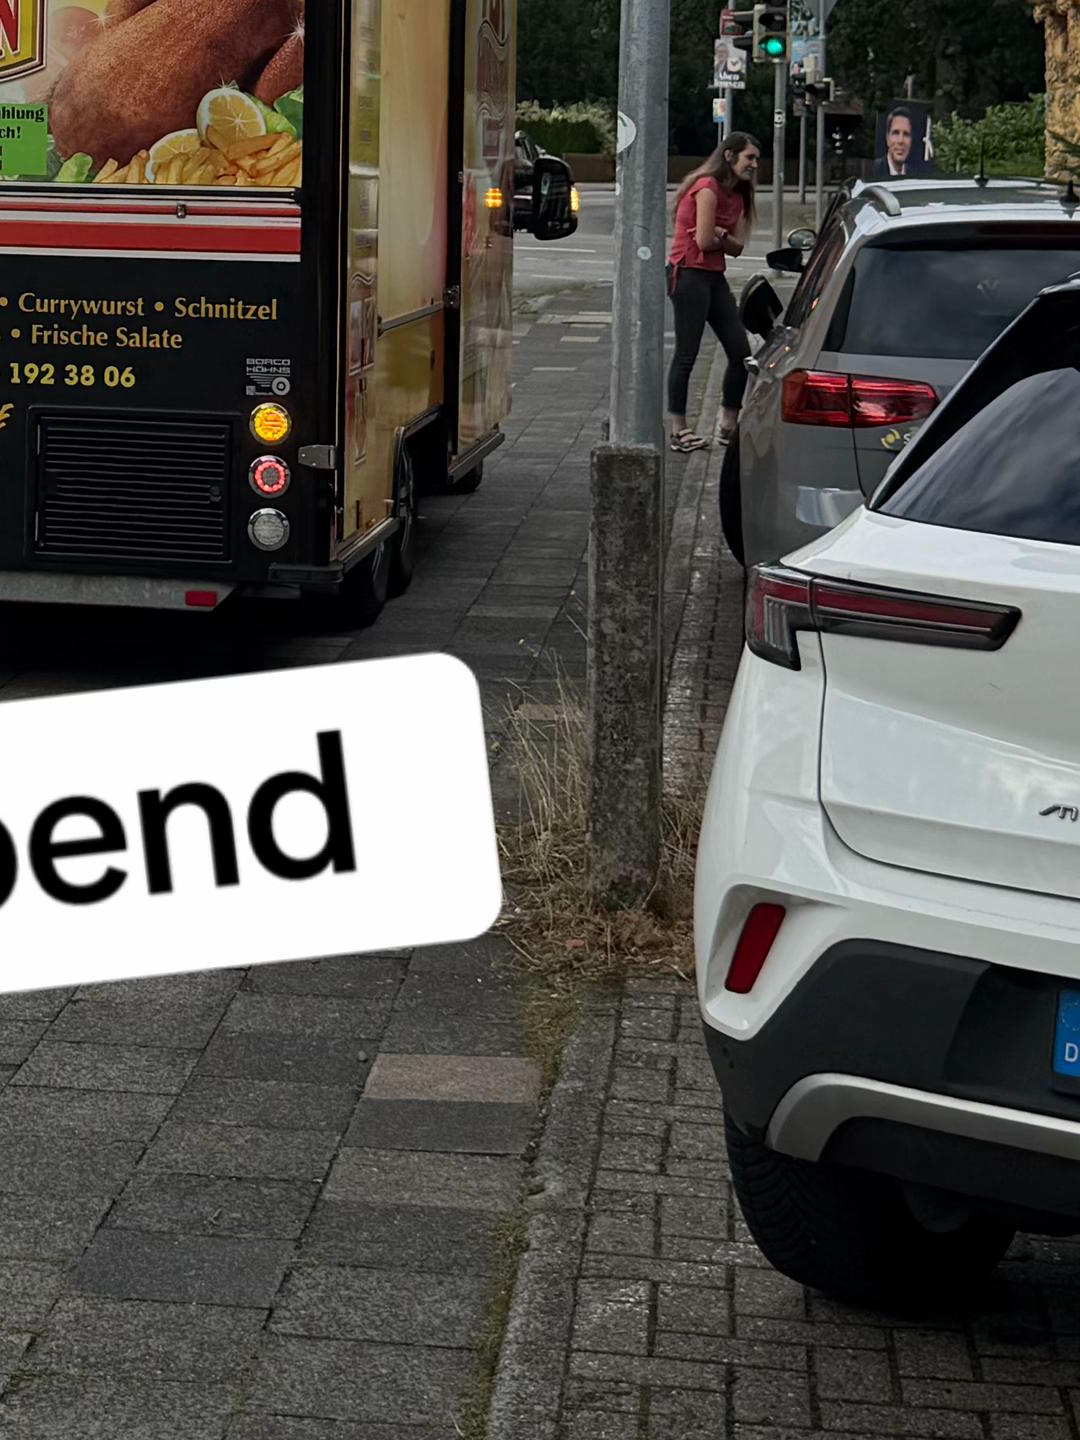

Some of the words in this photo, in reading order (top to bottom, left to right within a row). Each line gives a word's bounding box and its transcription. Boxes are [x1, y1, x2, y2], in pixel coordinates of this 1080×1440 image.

[18, 292, 145, 320] Currywurst
[174, 296, 278, 321] Schnitzel
[31, 324, 109, 347] Frische
[116, 326, 183, 349] Salate
[10, 362, 55, 385] 192
[64, 364, 95, 387] 38
[104, 366, 136, 389] 06
[1064, 1042, 1078, 1062] D
